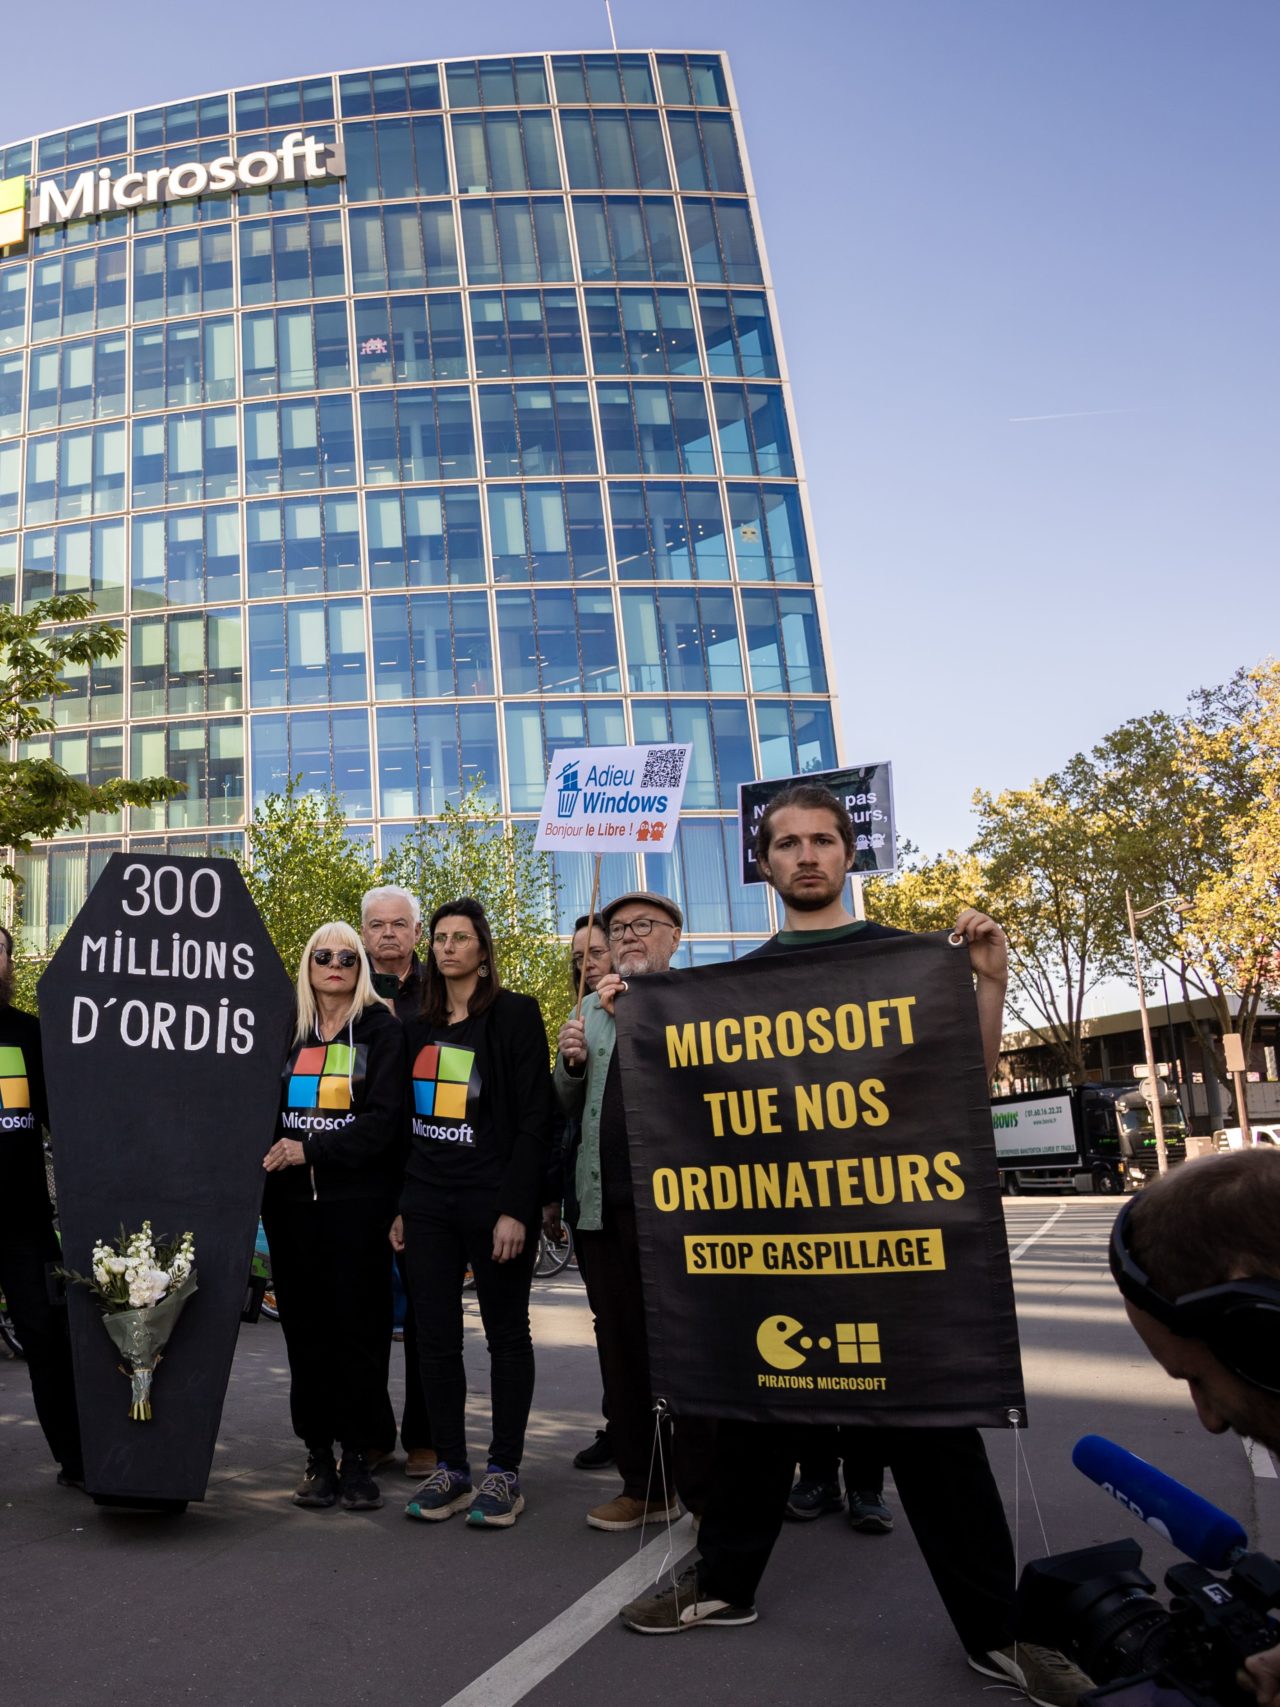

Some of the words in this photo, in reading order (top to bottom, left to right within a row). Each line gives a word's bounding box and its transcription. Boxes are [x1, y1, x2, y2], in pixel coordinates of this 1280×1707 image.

[39, 132, 327, 225] Microsoft
[585, 765, 635, 787] Adieu
[583, 791, 668, 814] Windows
[845, 792, 877, 810] pas
[545, 823, 583, 839] Bonjour
[585, 823, 594, 836] le
[597, 823, 626, 836] Libre
[121, 863, 222, 918] 300
[665, 996, 916, 1068] MICROSOFT
[703, 1088, 782, 1137] TUE
[794, 1078, 890, 1132] NOS
[412, 1117, 474, 1143] Microsoft
[652, 1151, 965, 1212] ORDINATEURS
[691, 1242, 754, 1270] STOP
[762, 1237, 933, 1271] GASPILLAGE
[757, 1374, 814, 1389] PIRATONS
[817, 1377, 887, 1391] MICROSOFT
